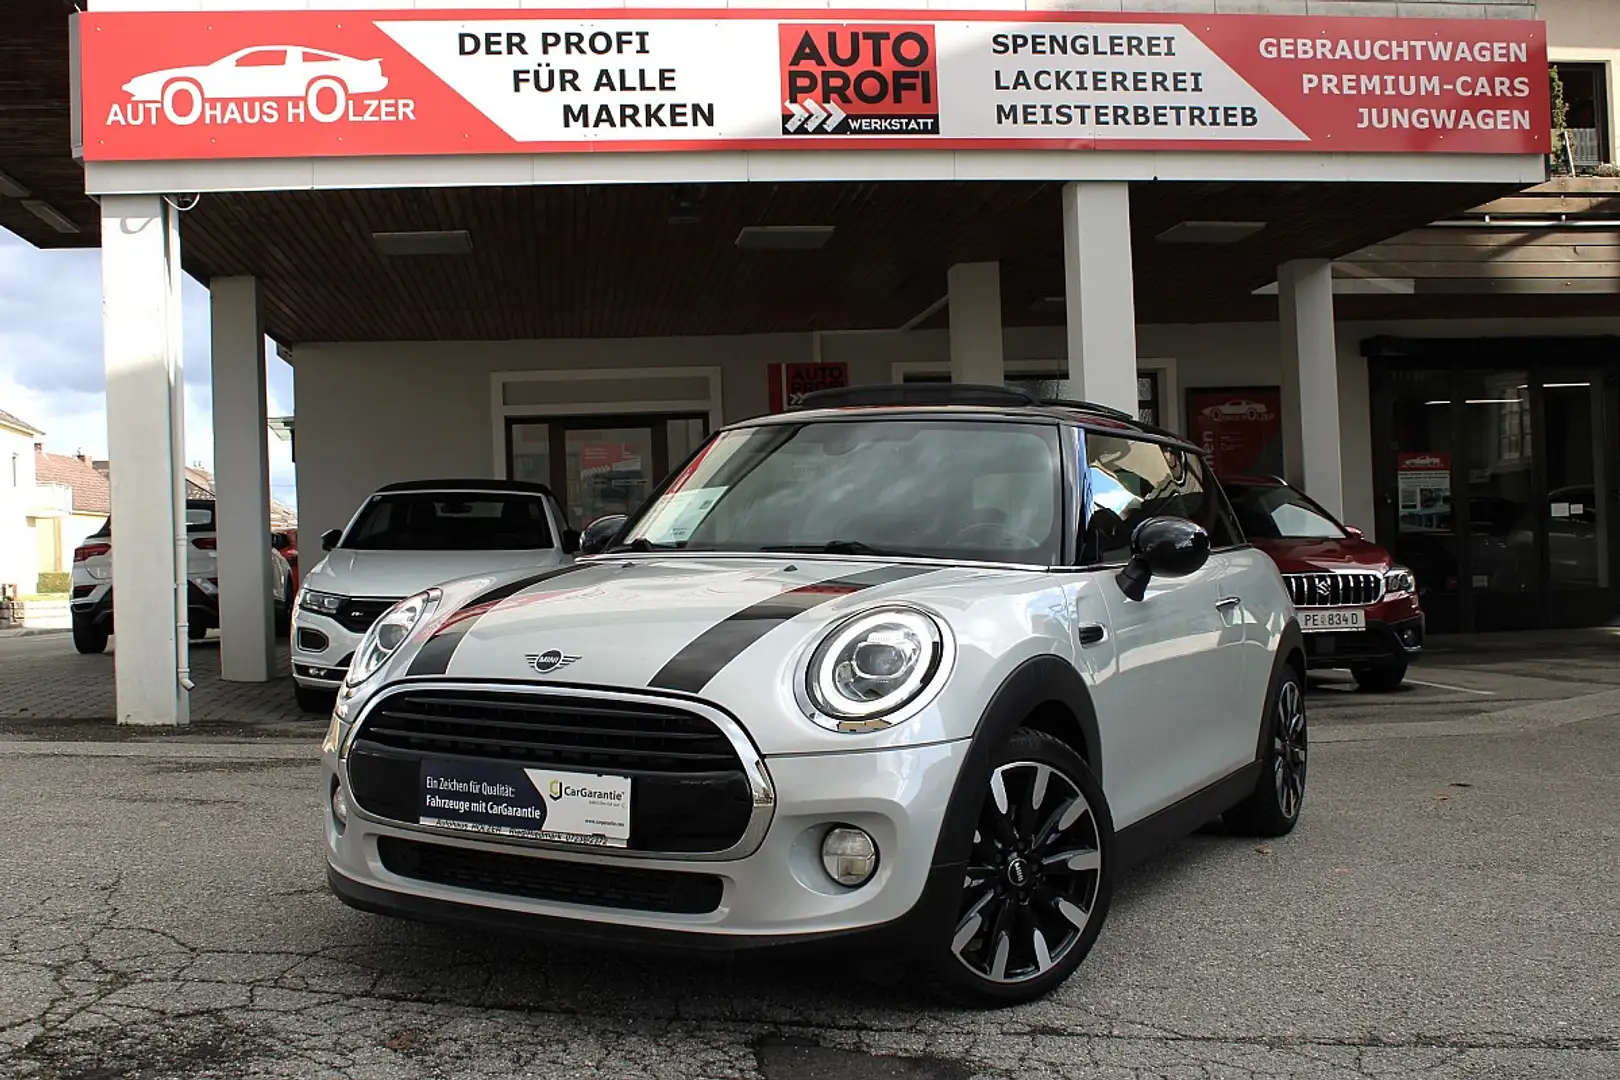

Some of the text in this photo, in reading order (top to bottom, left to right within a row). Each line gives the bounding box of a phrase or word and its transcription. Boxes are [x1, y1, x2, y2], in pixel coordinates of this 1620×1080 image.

[458, 31, 650, 56] DER PROFI
[789, 30, 929, 68] AUTO
[992, 34, 1176, 57] SPENGLEREI
[1258, 37, 1527, 63] GEBRAUCHTWAGEN
[513, 63, 677, 93] FÜR ALLE
[788, 70, 932, 105] PROFI
[994, 70, 1203, 92] LACKIEREREI
[1302, 73, 1530, 97] PREMIUM-CARS
[106, 77, 416, 126] AUTOHAUS HOLZER
[562, 102, 714, 128] MARKEN
[847, 118, 934, 131] WERKSTATT
[996, 104, 1258, 127] MEISTERBETRIEB
[1356, 107, 1530, 130] JUNGWAGEN
[792, 366, 843, 381] AUTO
[1304, 613, 1358, 626] PE 834 D
[426, 776, 516, 798] Ein Zeichen für Qualität:
[564, 785, 623, 801] CarGarantie
[426, 795, 541, 819] Fahrzeuge mit CarGarantie
